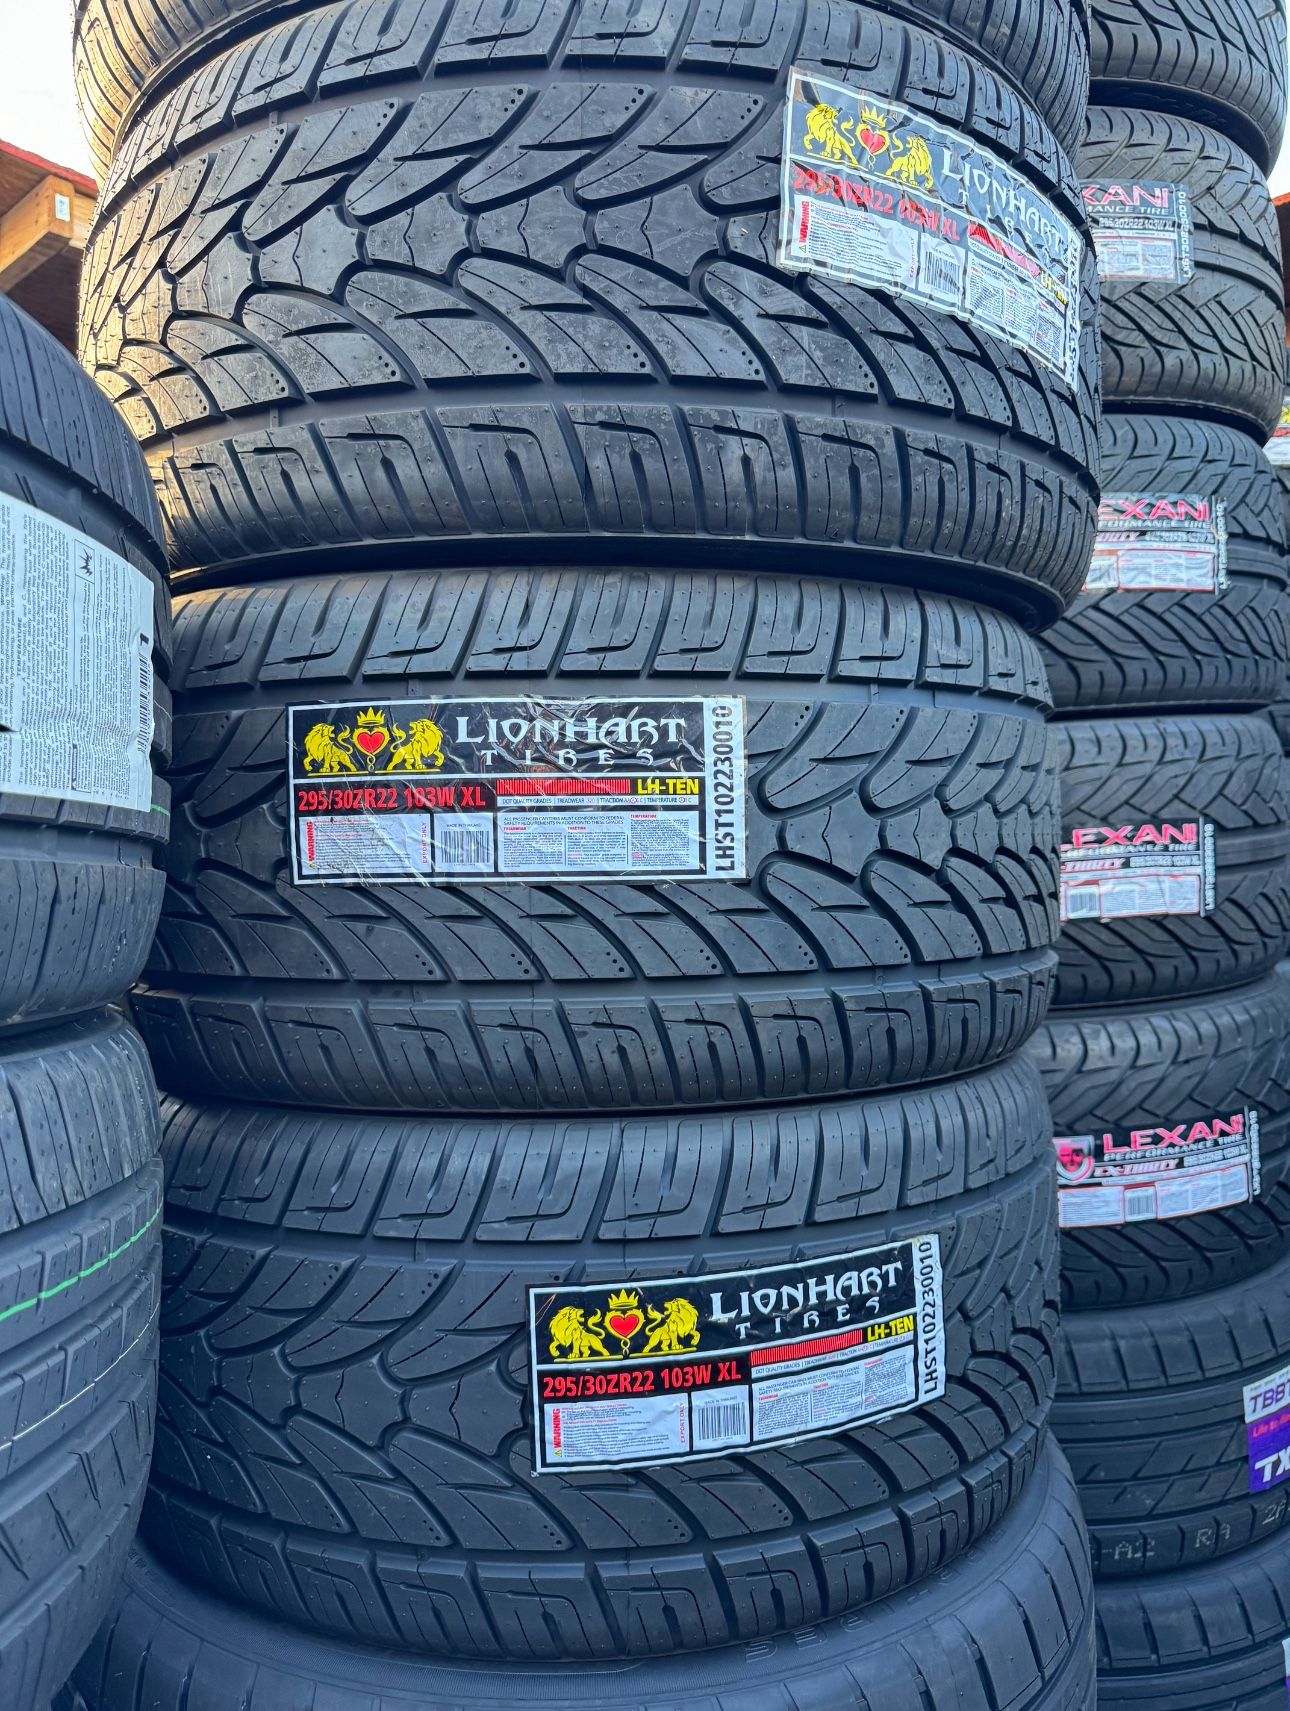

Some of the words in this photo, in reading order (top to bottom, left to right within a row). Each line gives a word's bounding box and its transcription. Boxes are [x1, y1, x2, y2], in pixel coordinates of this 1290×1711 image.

[942, 147, 1066, 258] LIONHART
[1140, 206, 1169, 216] TIRE
[799, 201, 809, 243] WARNING
[942, 218, 960, 240] XL
[455, 716, 686, 746] LIONHART
[481, 749, 654, 768] TIRES
[298, 787, 398, 811] 295/30ZR22
[403, 786, 454, 808] 103W
[460, 786, 486, 808] XL
[637, 778, 700, 795] LH-TEN
[711, 705, 735, 873] LHST102230010
[1060, 823, 1198, 850] EXANI
[1102, 1113, 1244, 1154] LEXANI
[1103, 1139, 1215, 1162] PERFORMANCE
[710, 1261, 903, 1320] LIONHART
[735, 1297, 881, 1340] TIRES
[867, 1315, 914, 1342] LH-TEN
[918, 1241, 938, 1395] LHST102230010
[543, 1370, 655, 1398] 295/30ZR22
[660, 1364, 712, 1389] 103W
[718, 1361, 742, 1381] XL
[553, 1408, 562, 1448] WARNING
